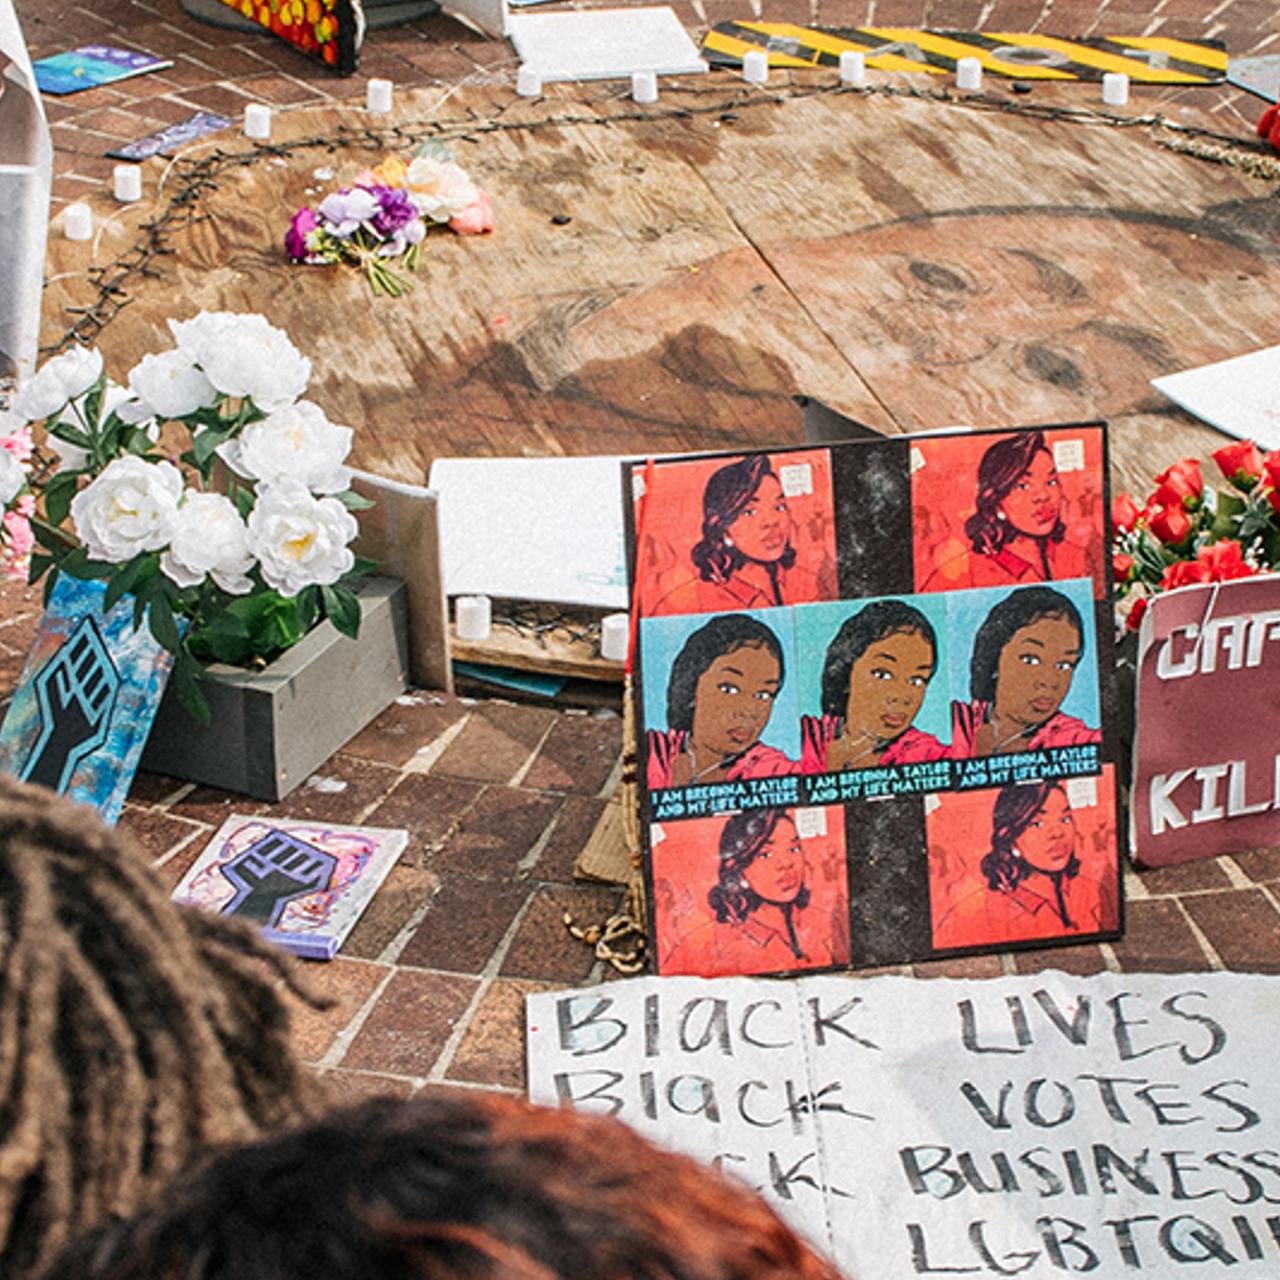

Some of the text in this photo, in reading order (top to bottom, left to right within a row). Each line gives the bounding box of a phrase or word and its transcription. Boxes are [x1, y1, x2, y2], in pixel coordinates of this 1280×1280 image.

[956, 745, 1097, 775] I AM BREONNA TAYLOR
[960, 760, 1098, 787] AND MY LIFE MATTERS
[806, 761, 950, 790] I AM BREONNA TAYLOR
[810, 775, 951, 803] AND MY LIFE MATTERS
[652, 776, 798, 805] I AM BREONNA TAYLOR
[656, 790, 799, 818] AND MY LIFE MATTERS
[958, 988, 1226, 1066] LIVES
[959, 1074, 1262, 1133] VOTES
